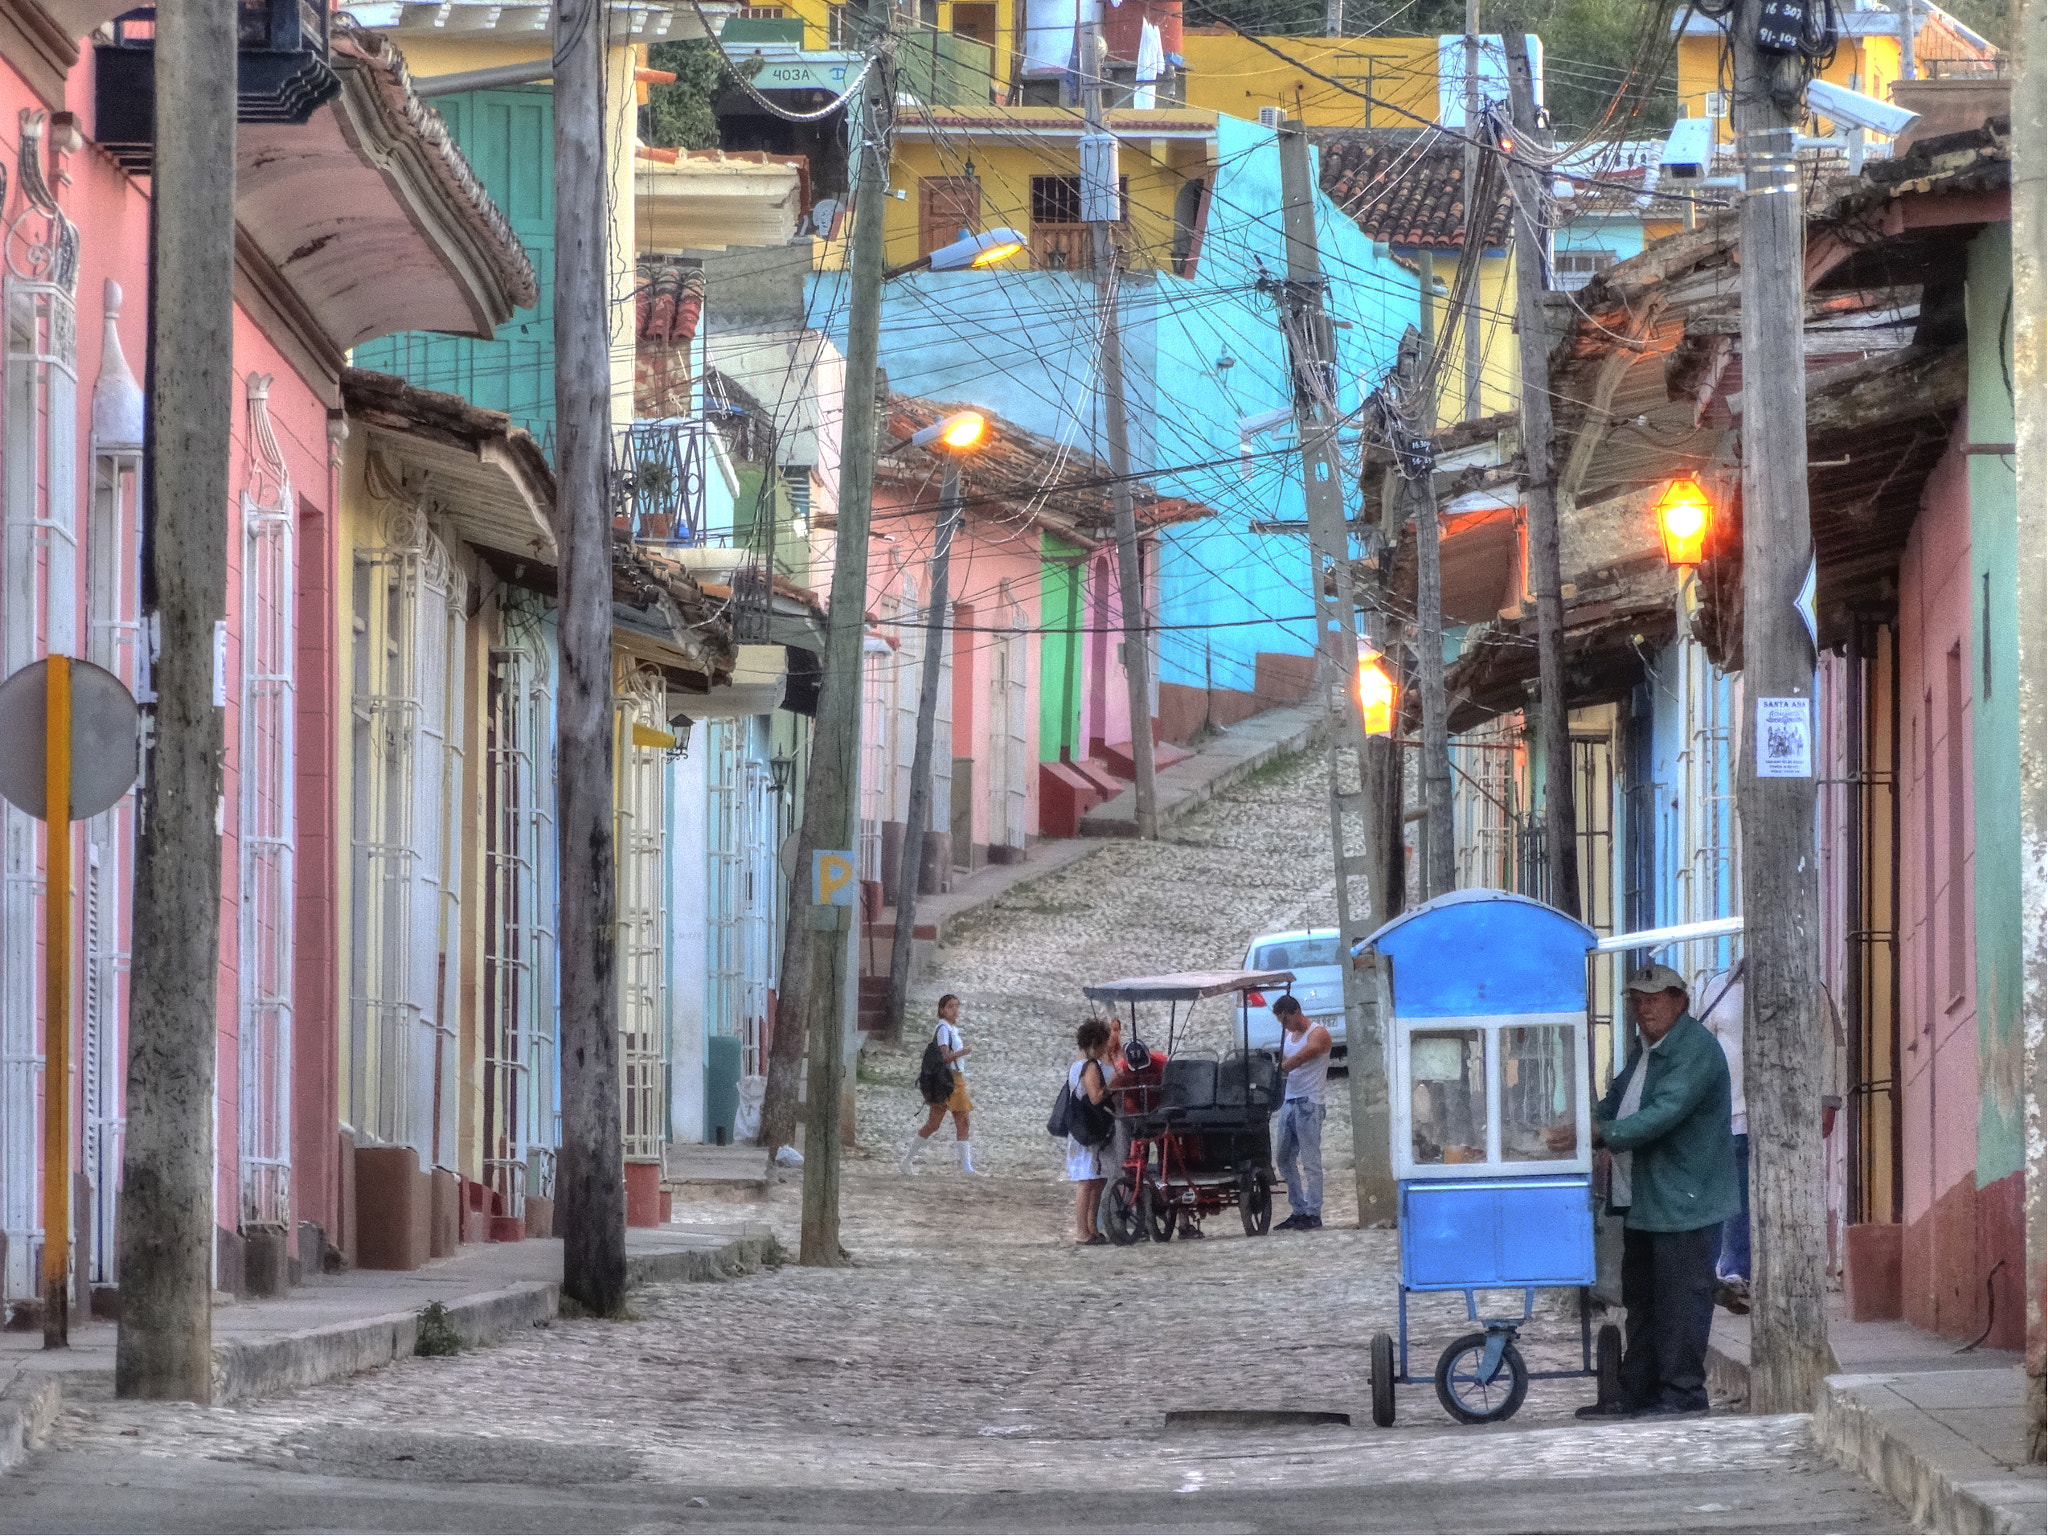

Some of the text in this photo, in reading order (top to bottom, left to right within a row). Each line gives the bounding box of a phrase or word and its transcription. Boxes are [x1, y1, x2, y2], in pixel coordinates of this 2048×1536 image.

[1765, 2, 1778, 15] 16
[773, 69, 810, 81] 403A
[819, 854, 854, 905] P
